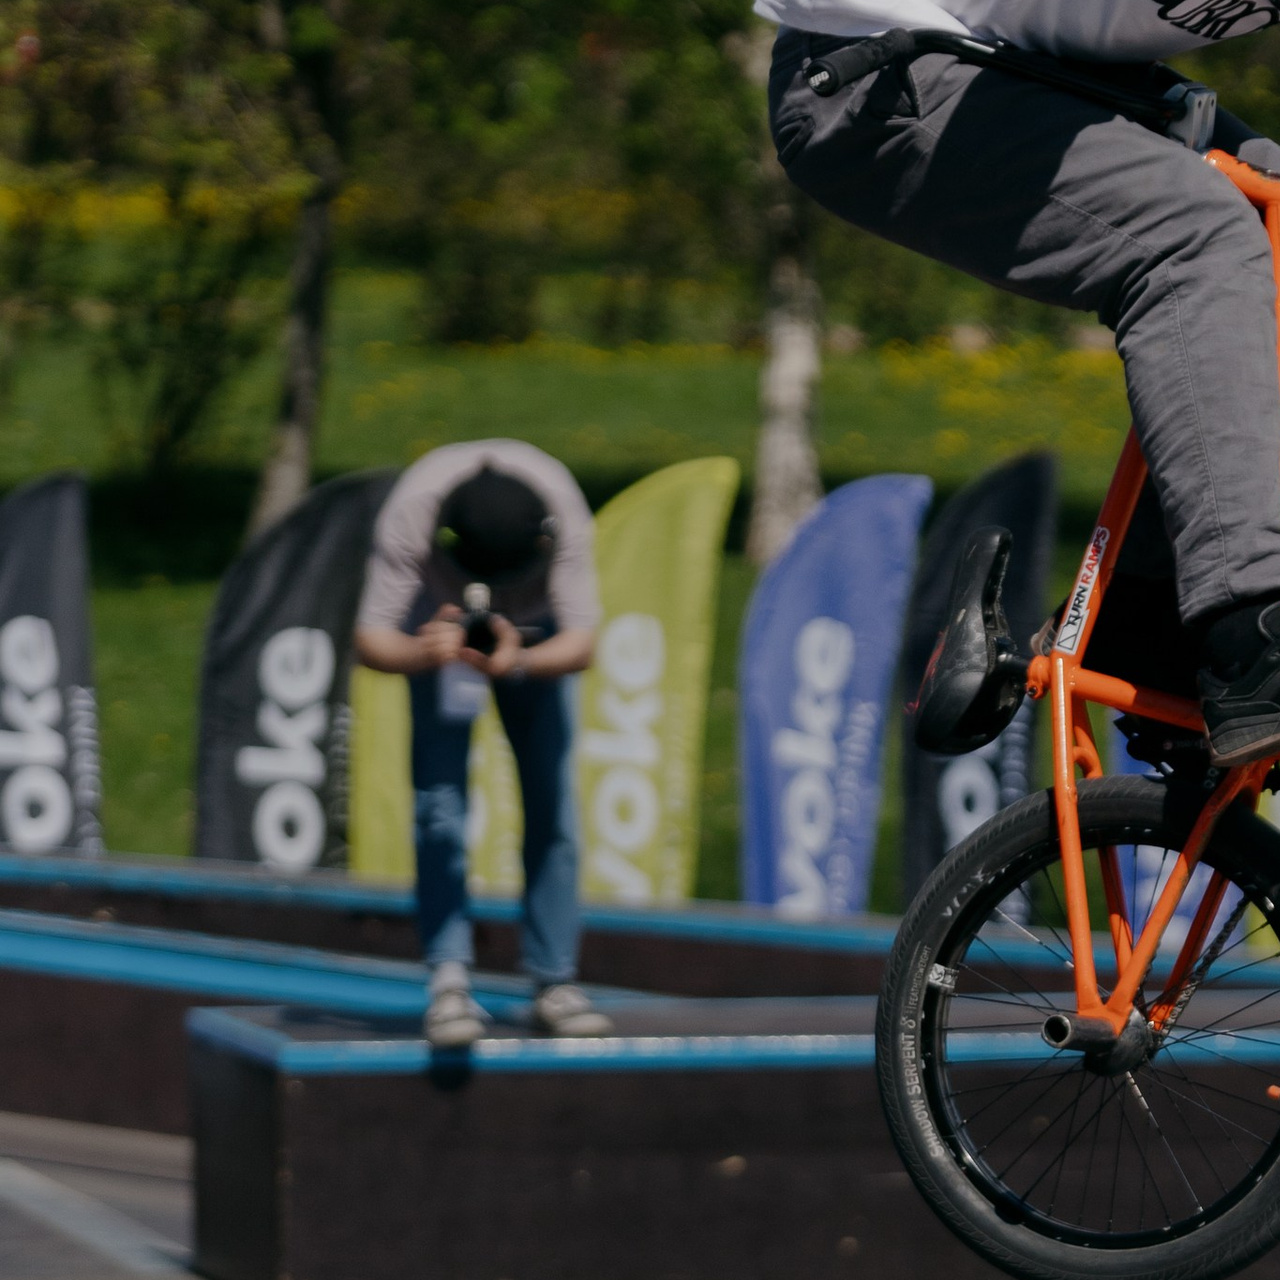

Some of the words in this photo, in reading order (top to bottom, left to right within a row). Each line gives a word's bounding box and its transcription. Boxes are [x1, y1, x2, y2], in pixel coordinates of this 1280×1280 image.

[1067, 586, 1087, 626] TURN
[1082, 529, 1108, 584] RAMPS
[899, 1032, 920, 1095] SERPENT
[911, 1099, 944, 1158] SHADOW
